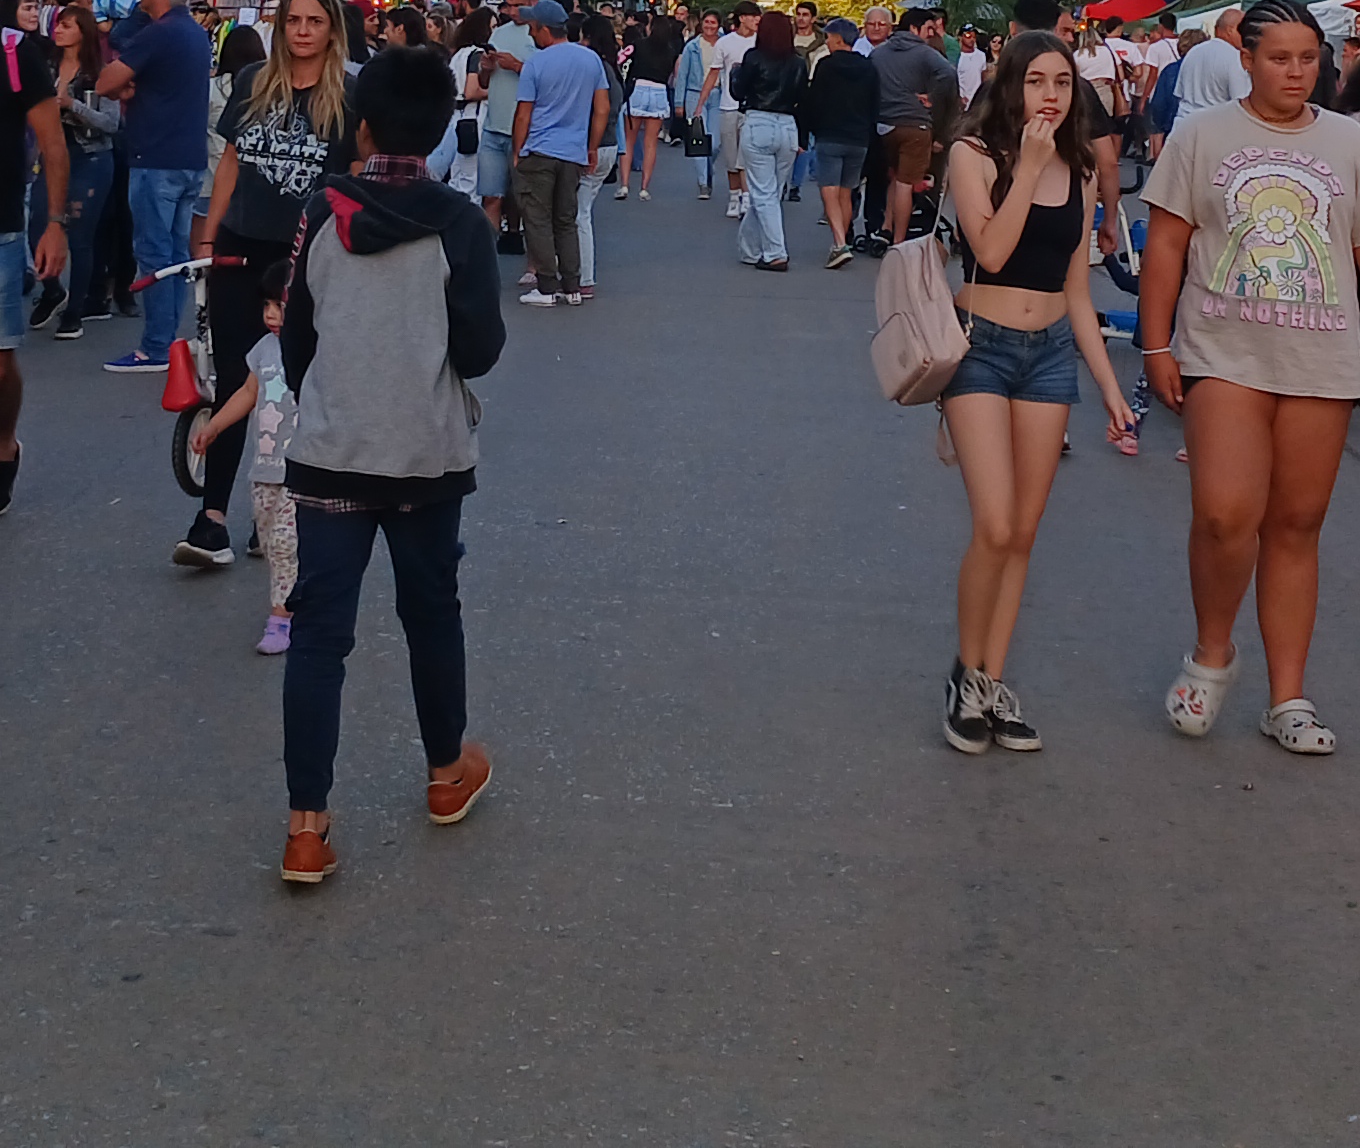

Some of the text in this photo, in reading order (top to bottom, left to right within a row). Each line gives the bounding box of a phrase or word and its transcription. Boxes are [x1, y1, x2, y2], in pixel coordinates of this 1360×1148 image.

[1211, 145, 1345, 197] DEPENDS
[1202, 295, 1348, 332] ON NOTHING
